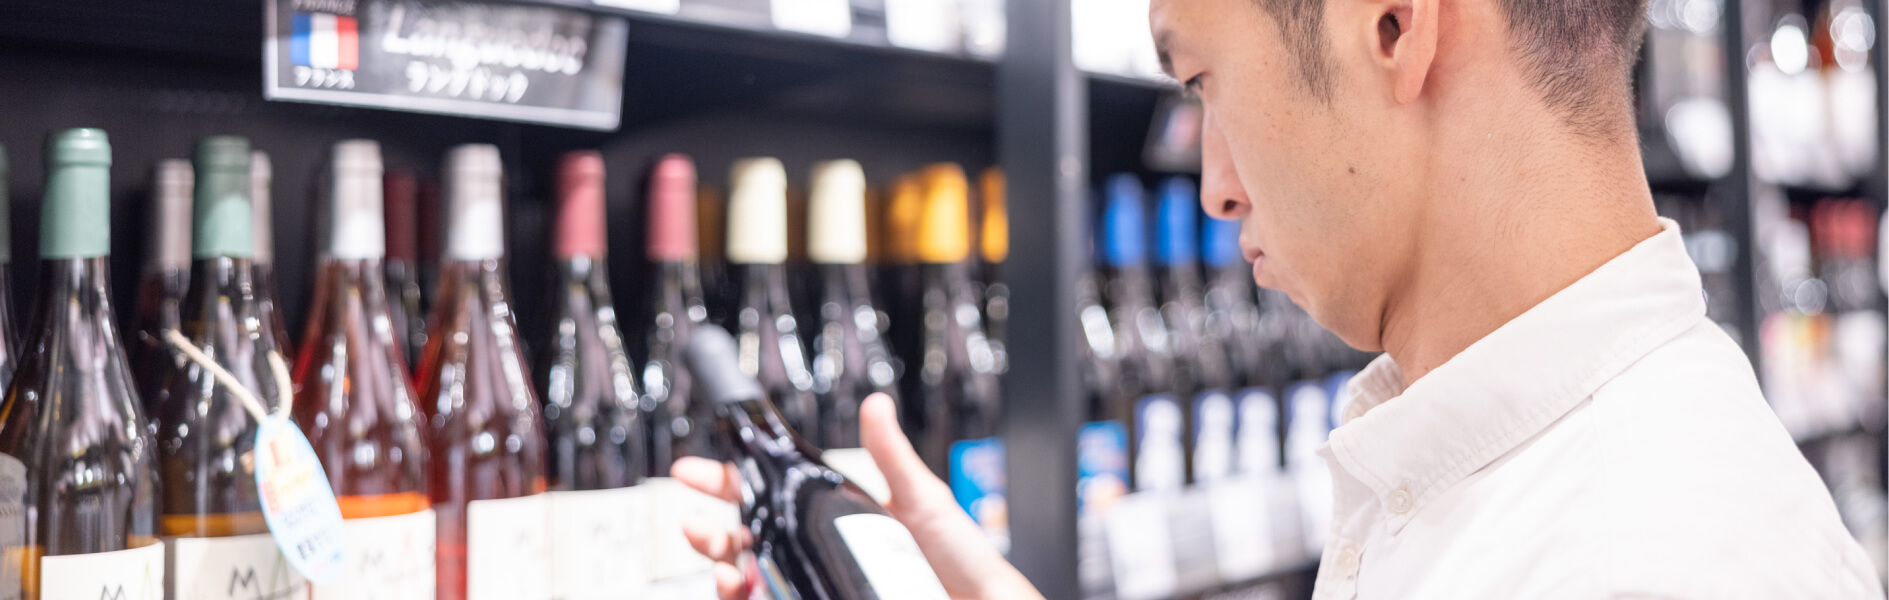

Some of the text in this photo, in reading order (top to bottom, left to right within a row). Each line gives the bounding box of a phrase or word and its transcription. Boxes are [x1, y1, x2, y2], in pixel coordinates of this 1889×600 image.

[382, 5, 587, 75] Languedoc
[294, 66, 355, 90] フランス
[405, 60, 529, 103] ラングドック
